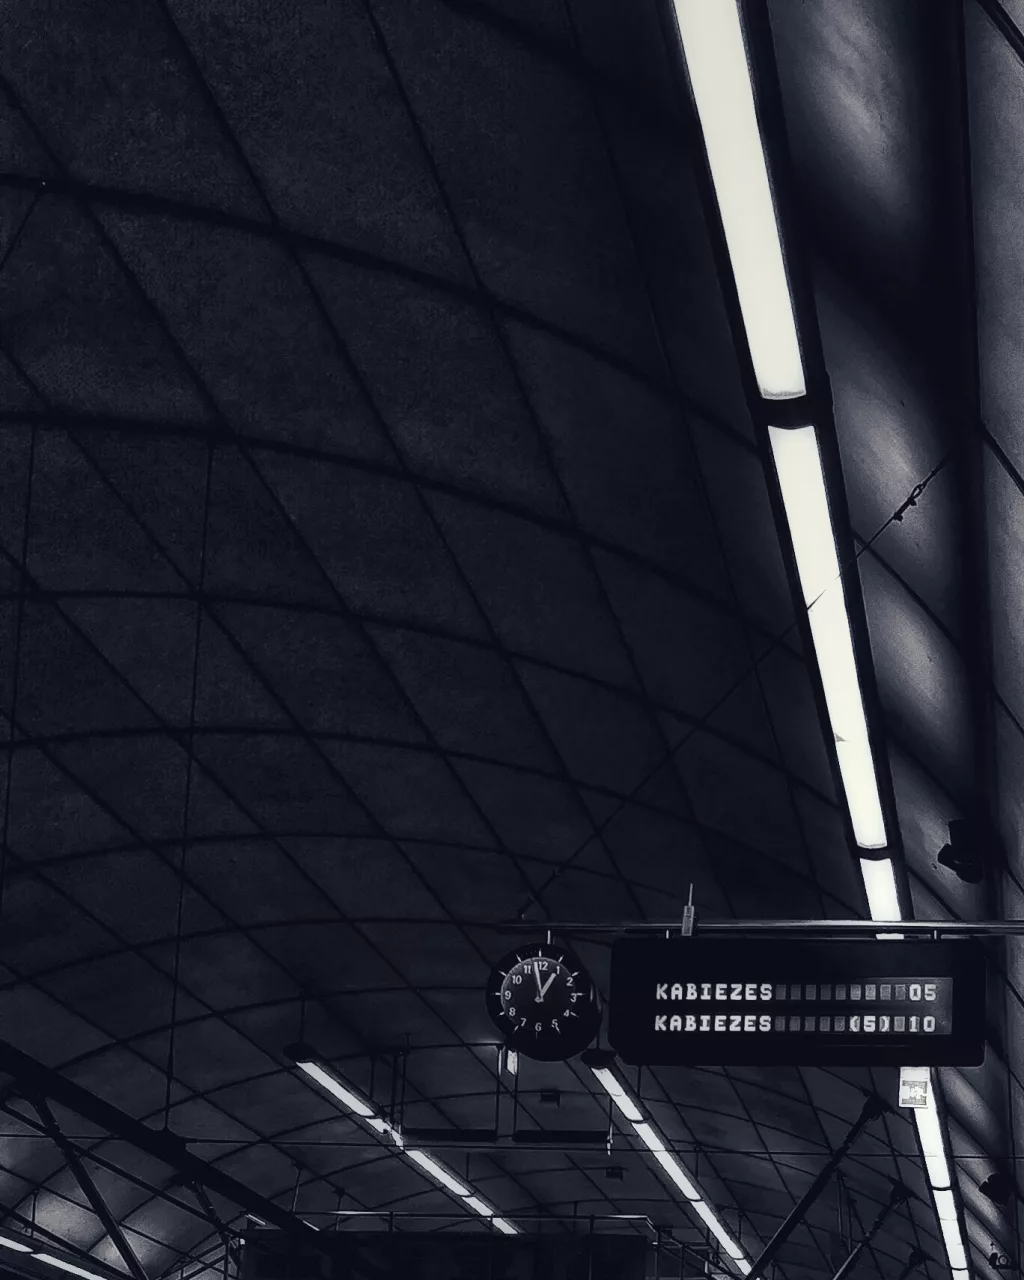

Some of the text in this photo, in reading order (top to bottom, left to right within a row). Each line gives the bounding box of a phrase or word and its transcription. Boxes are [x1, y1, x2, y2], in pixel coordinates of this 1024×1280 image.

[523, 964, 532, 975] 11
[538, 961, 549, 971] 12
[555, 965, 561, 975] 1
[511, 974, 523, 985] 10
[565, 977, 574, 987] 2
[504, 990, 512, 1001] 9
[656, 983, 937, 1001] KABIEZES 05
[570, 992, 577, 1003] 3
[508, 1007, 516, 1017] 8
[563, 1009, 570, 1018] 4
[520, 1017, 527, 1027] 7
[534, 1022, 542, 1032] 6
[550, 1019, 559, 1028] 5
[654, 1015, 936, 1033] KABIEZES (5) 10
